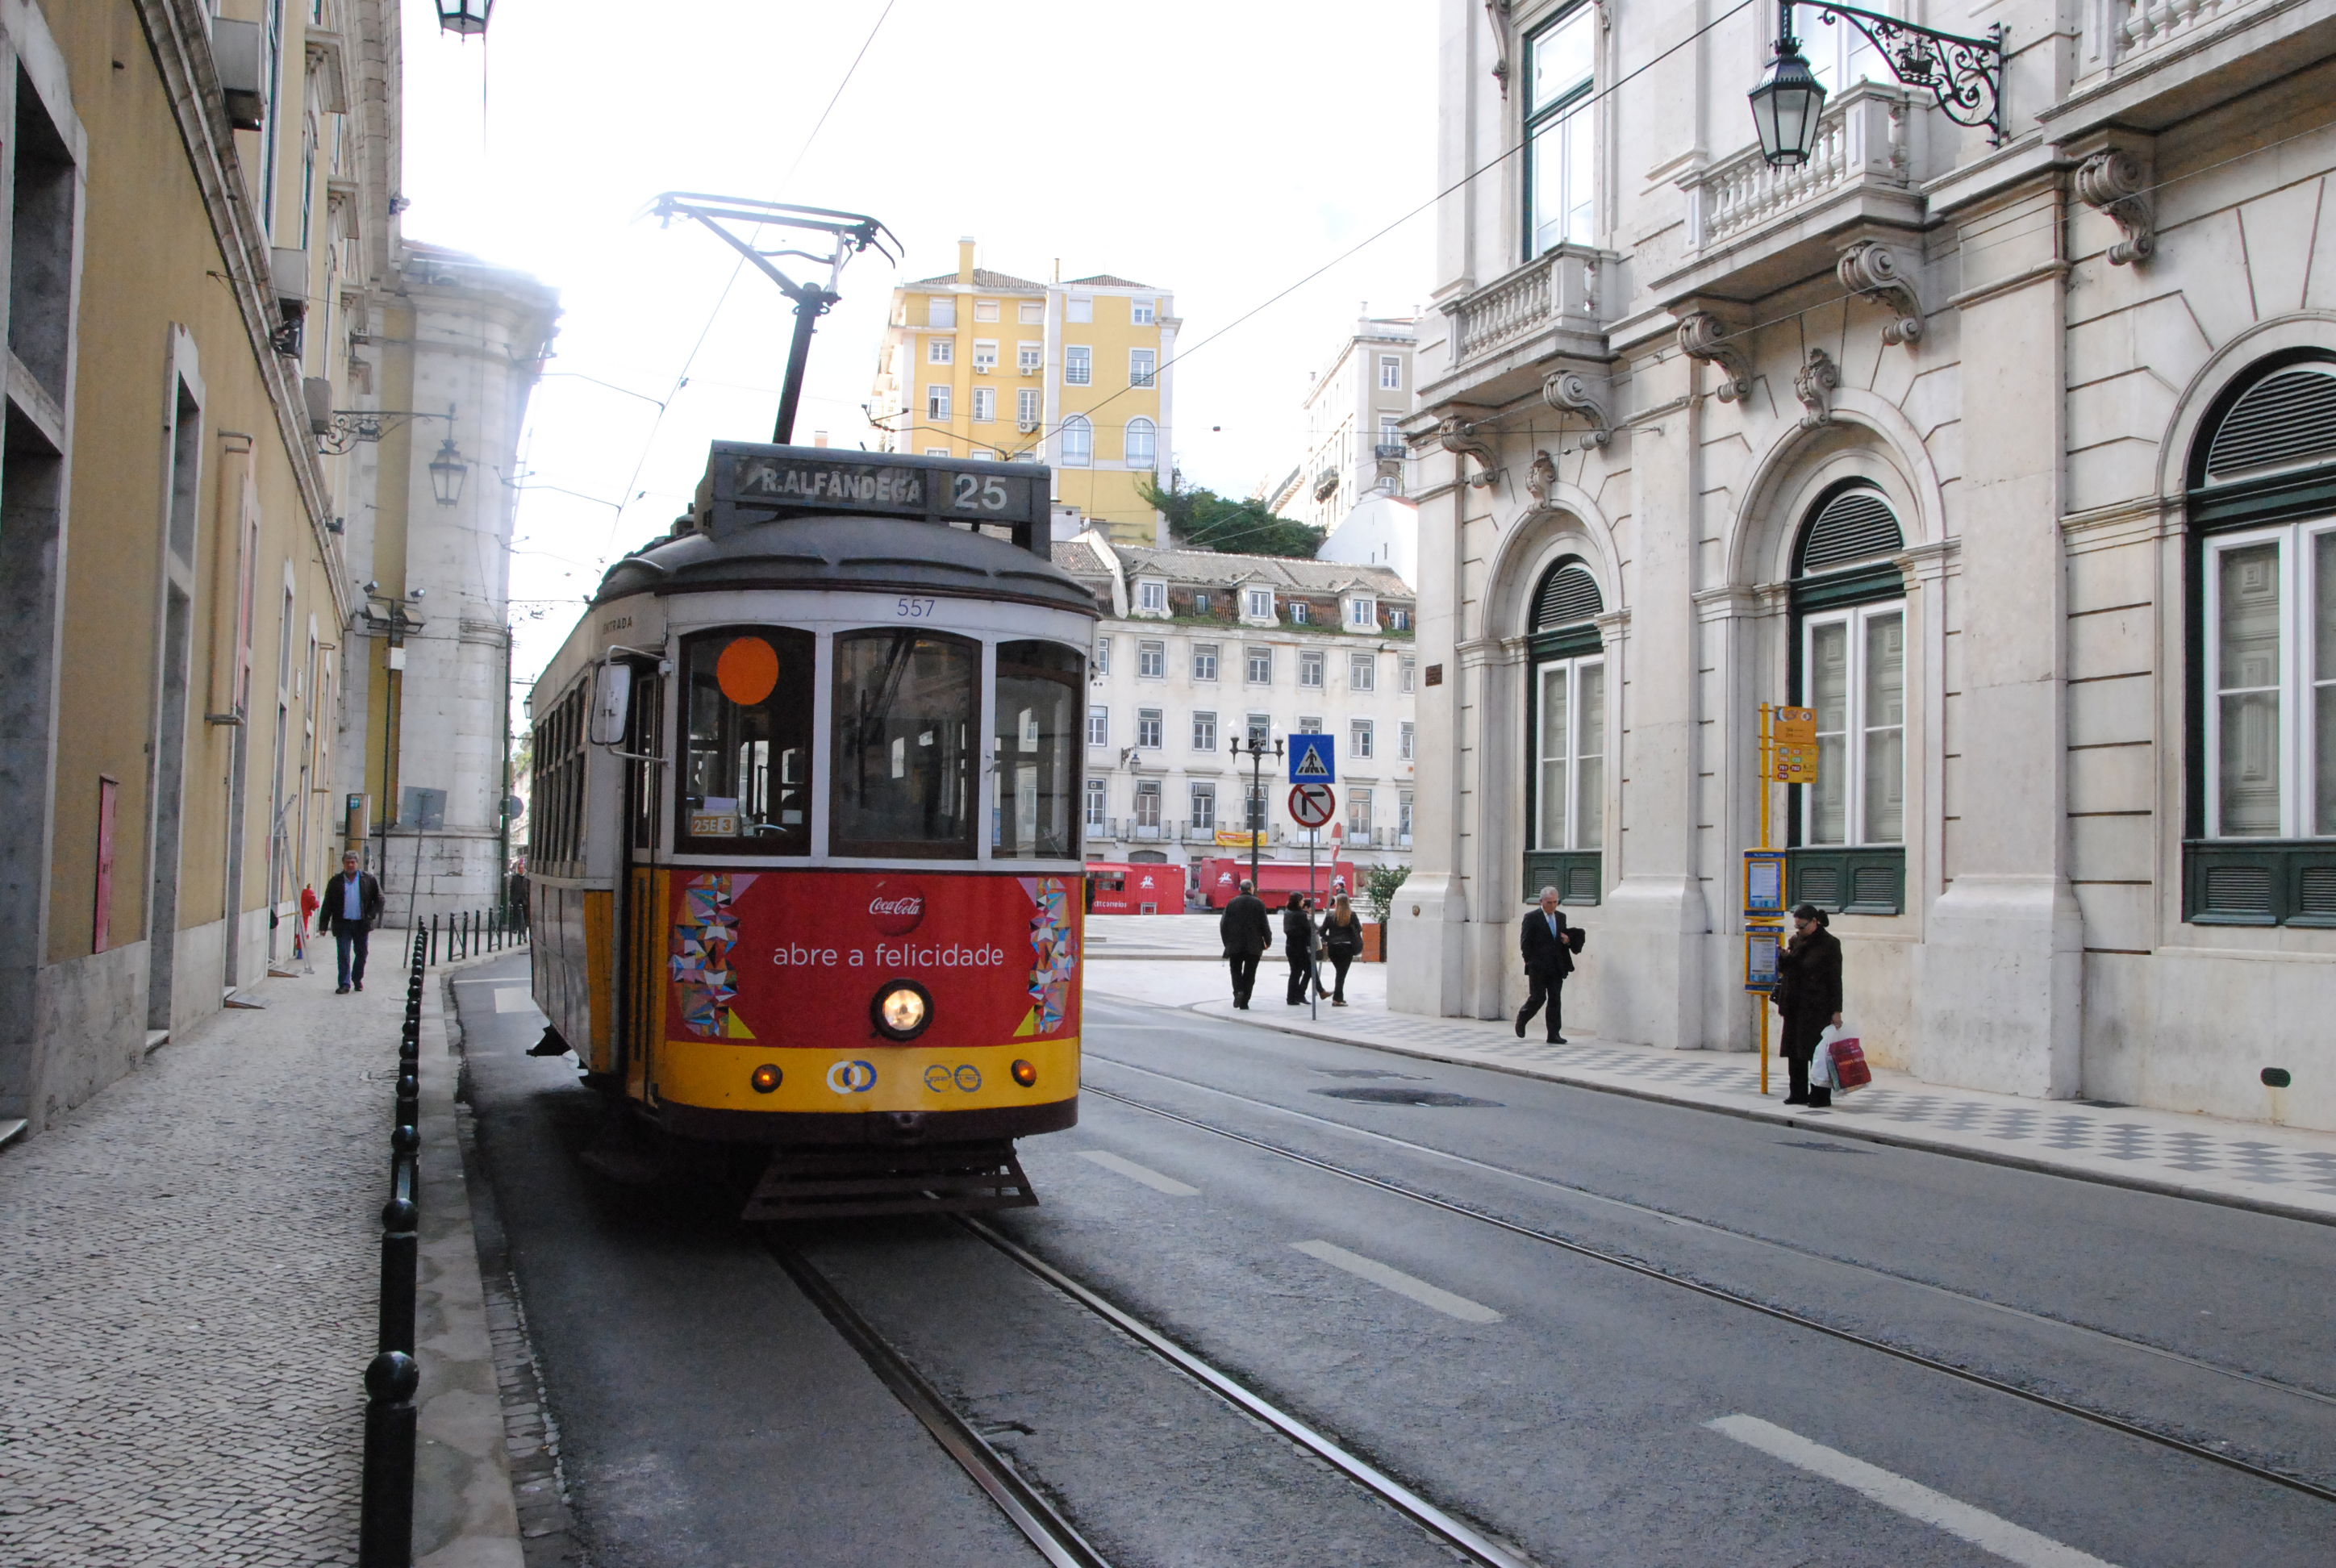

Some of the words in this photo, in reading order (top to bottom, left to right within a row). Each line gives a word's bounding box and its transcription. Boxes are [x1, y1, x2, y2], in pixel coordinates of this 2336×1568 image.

[761, 467, 920, 503] R.ALFÂNDEGA
[955, 473, 1007, 511] 25
[897, 598, 935, 617] 557
[694, 819, 717, 832] 25E
[869, 896, 923, 915] Coca-Cola
[773, 942, 837, 966] abre
[848, 949, 863, 966] a
[875, 943, 1004, 966] felicidade
